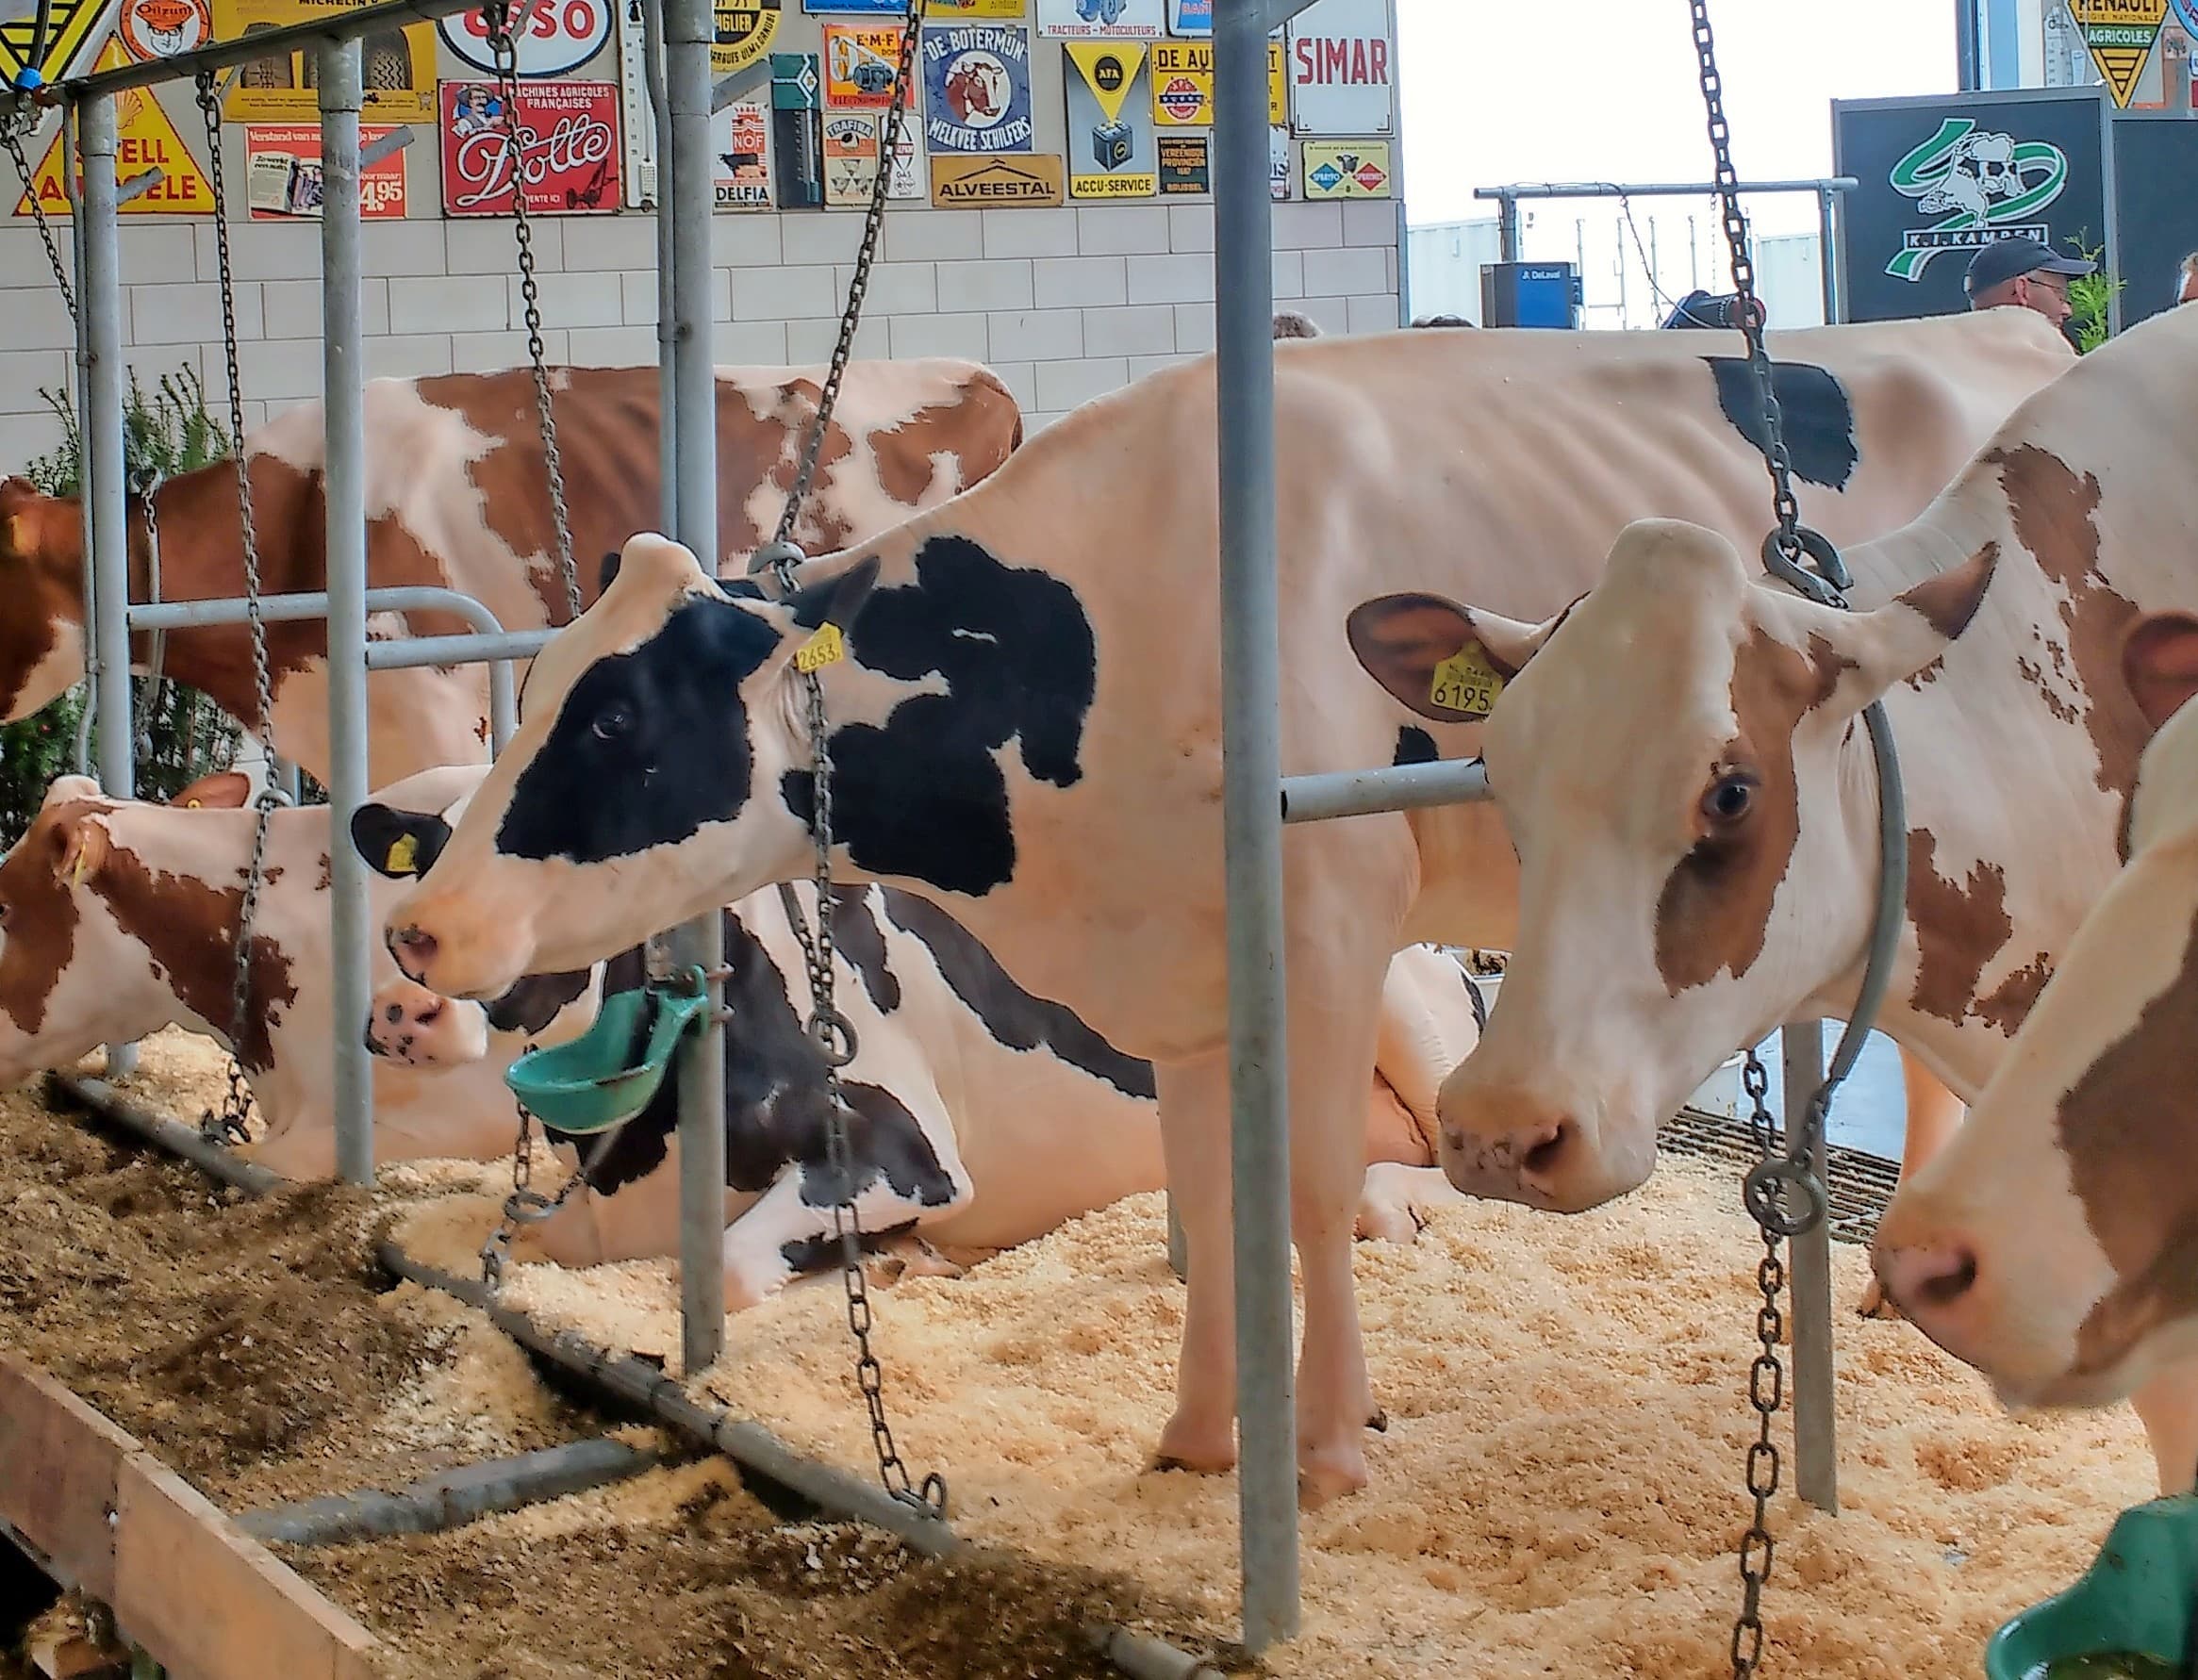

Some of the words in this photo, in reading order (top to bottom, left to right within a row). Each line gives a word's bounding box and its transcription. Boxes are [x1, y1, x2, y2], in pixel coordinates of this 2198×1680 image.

[1048, 25, 1091, 36] TRACTEURS
[1099, 25, 1156, 36] MOTOCULTEURS
[2088, 29, 2152, 43] AGRICOLES
[1158, 50, 1180, 67] DE
[1297, 38, 1389, 85] SIMAR
[560, 87, 609, 98] AGRICOLES
[526, 98, 593, 109] FRANÇAISES
[928, 116, 977, 151] MELKVEE
[980, 116, 1032, 151] SCHILFERS
[735, 135, 764, 149] NOF
[716, 188, 769, 201] DELFIA
[939, 182, 1056, 197] ALVEESTAL
[800, 643, 835, 669] 2653
[1434, 682, 1490, 711] 6195
